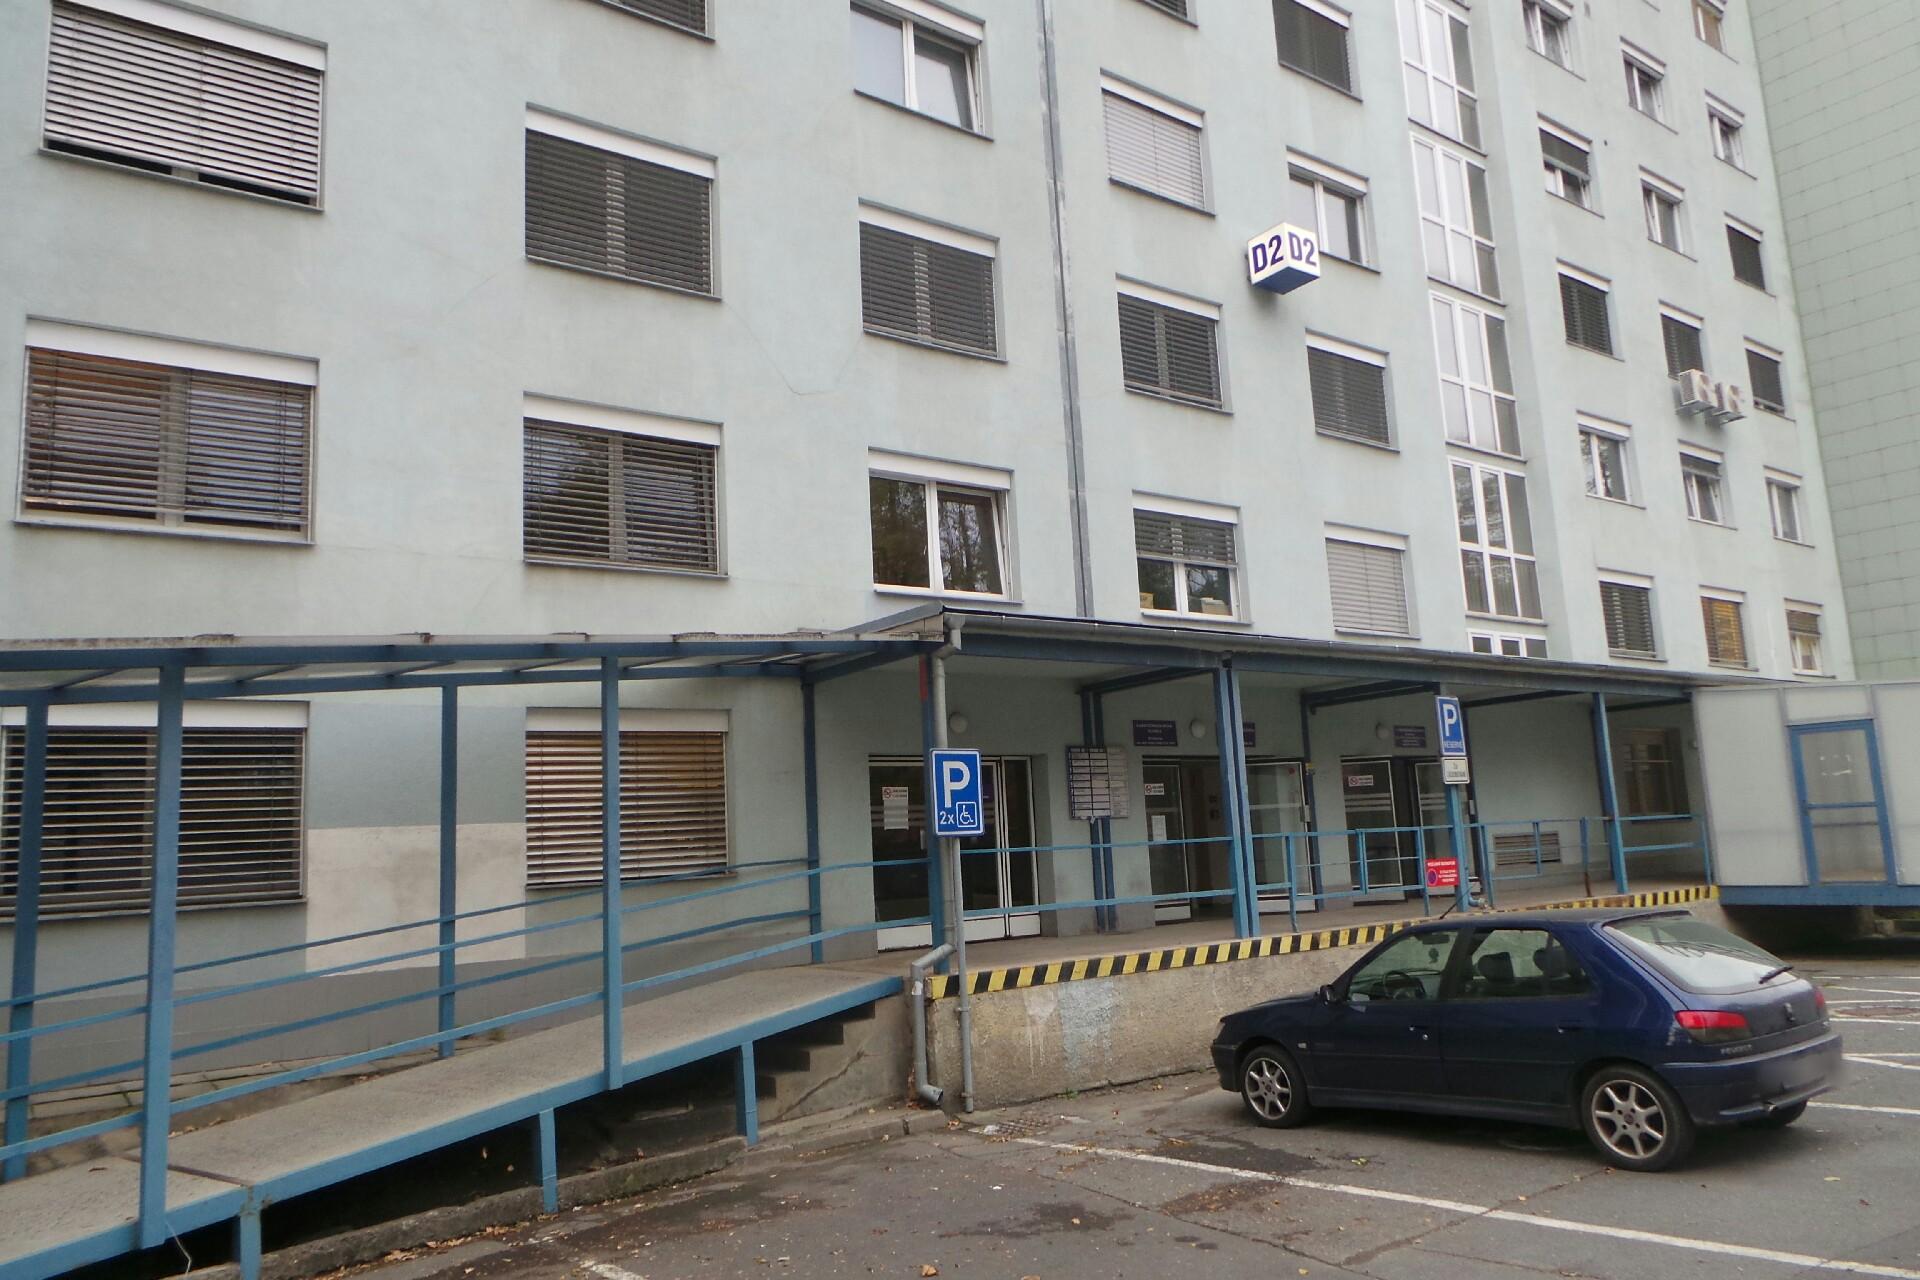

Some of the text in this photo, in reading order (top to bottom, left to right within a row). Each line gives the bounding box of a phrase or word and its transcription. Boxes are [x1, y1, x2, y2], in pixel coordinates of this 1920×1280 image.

[1252, 234, 1284, 274] D2
[1288, 231, 1317, 267] D2
[1442, 703, 1457, 737] P
[943, 760, 970, 808] P
[940, 810, 955, 825] 2x
